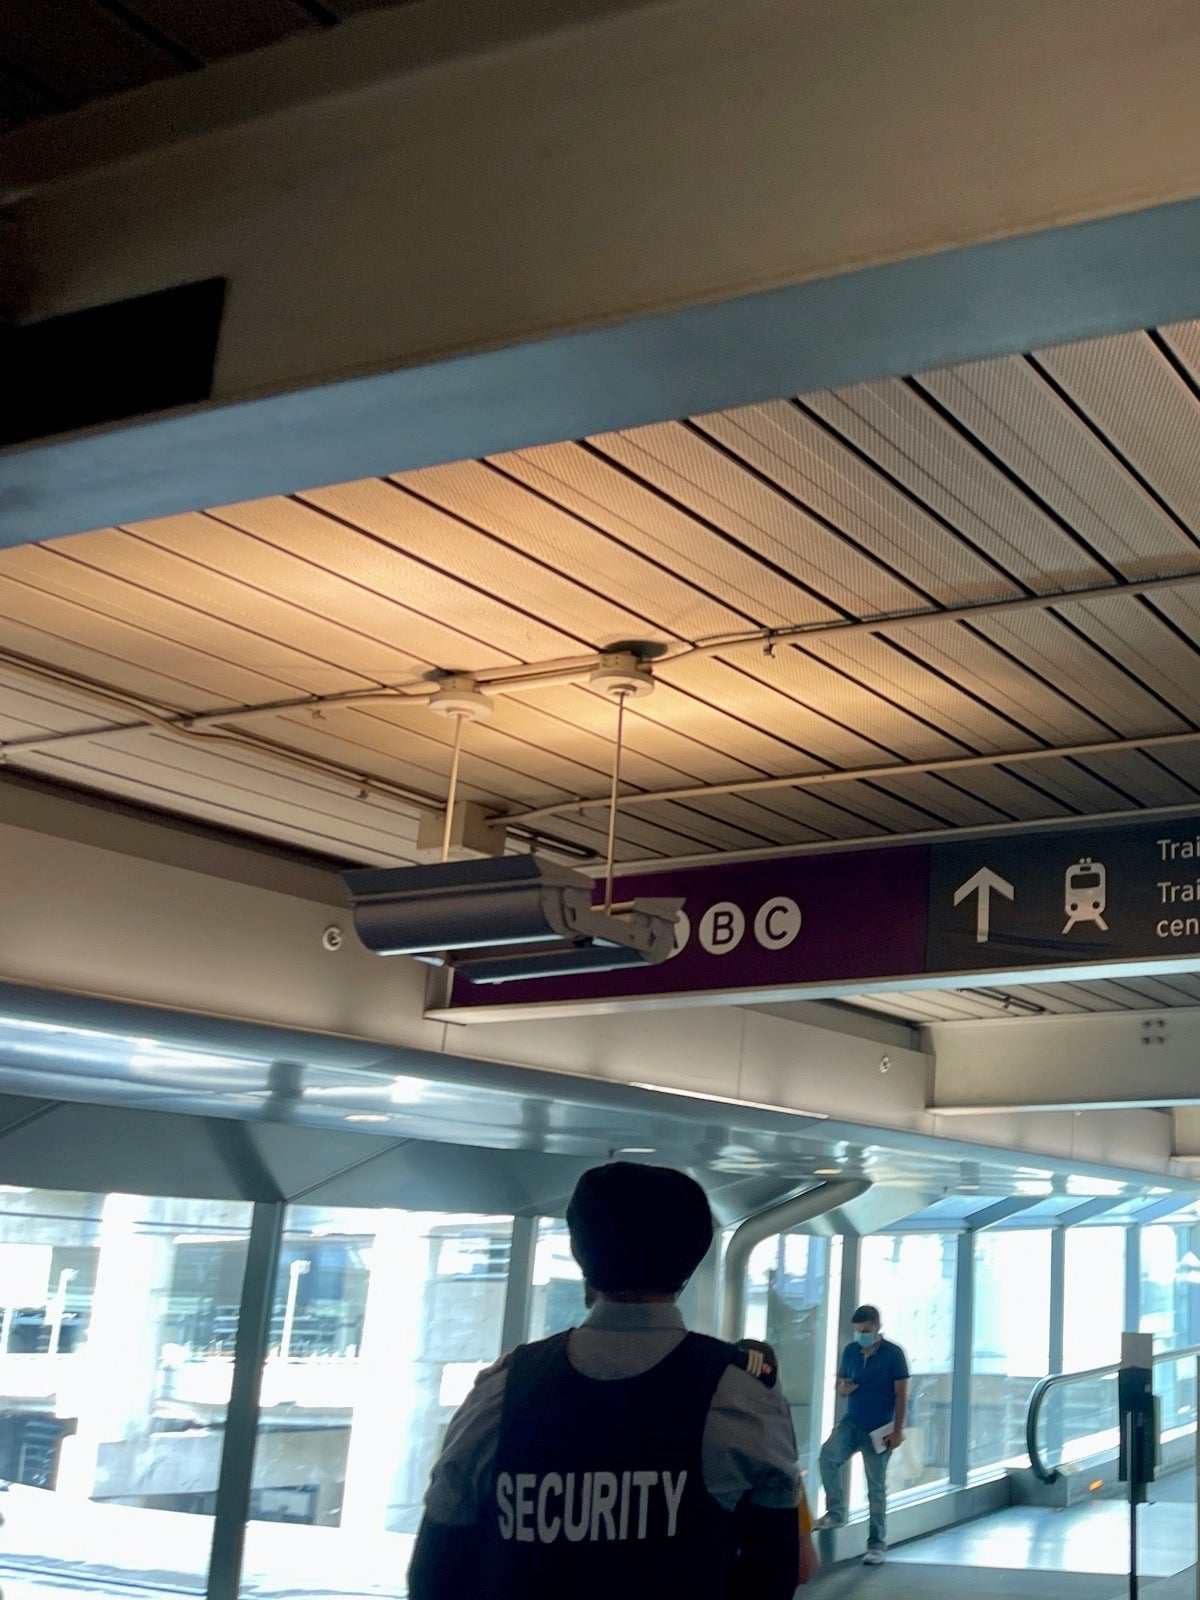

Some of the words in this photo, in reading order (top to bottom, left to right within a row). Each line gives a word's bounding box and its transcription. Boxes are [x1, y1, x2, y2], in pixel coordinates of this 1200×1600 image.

[711, 911, 734, 945] B
[765, 905, 789, 940] C
[496, 1471, 688, 1544] SECURITY
